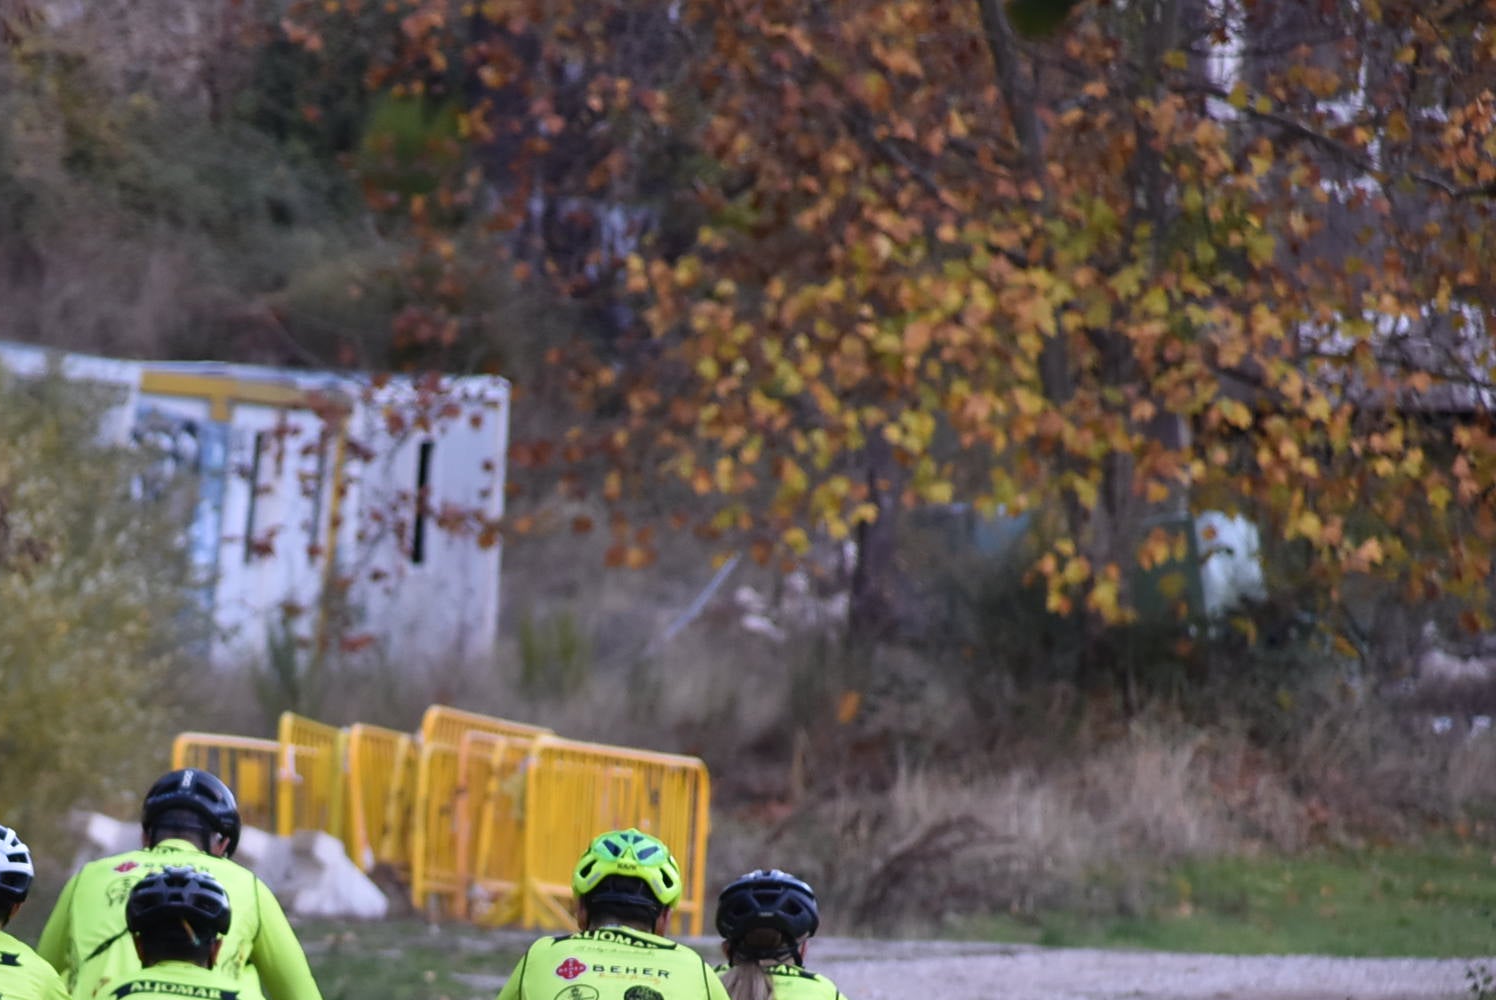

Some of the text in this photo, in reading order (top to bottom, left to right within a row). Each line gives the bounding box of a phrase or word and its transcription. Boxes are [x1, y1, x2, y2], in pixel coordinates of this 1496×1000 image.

[570, 930, 657, 949] ALJOM
[592, 964, 671, 979] BEHER
[130, 981, 221, 999] ALJOMAR
